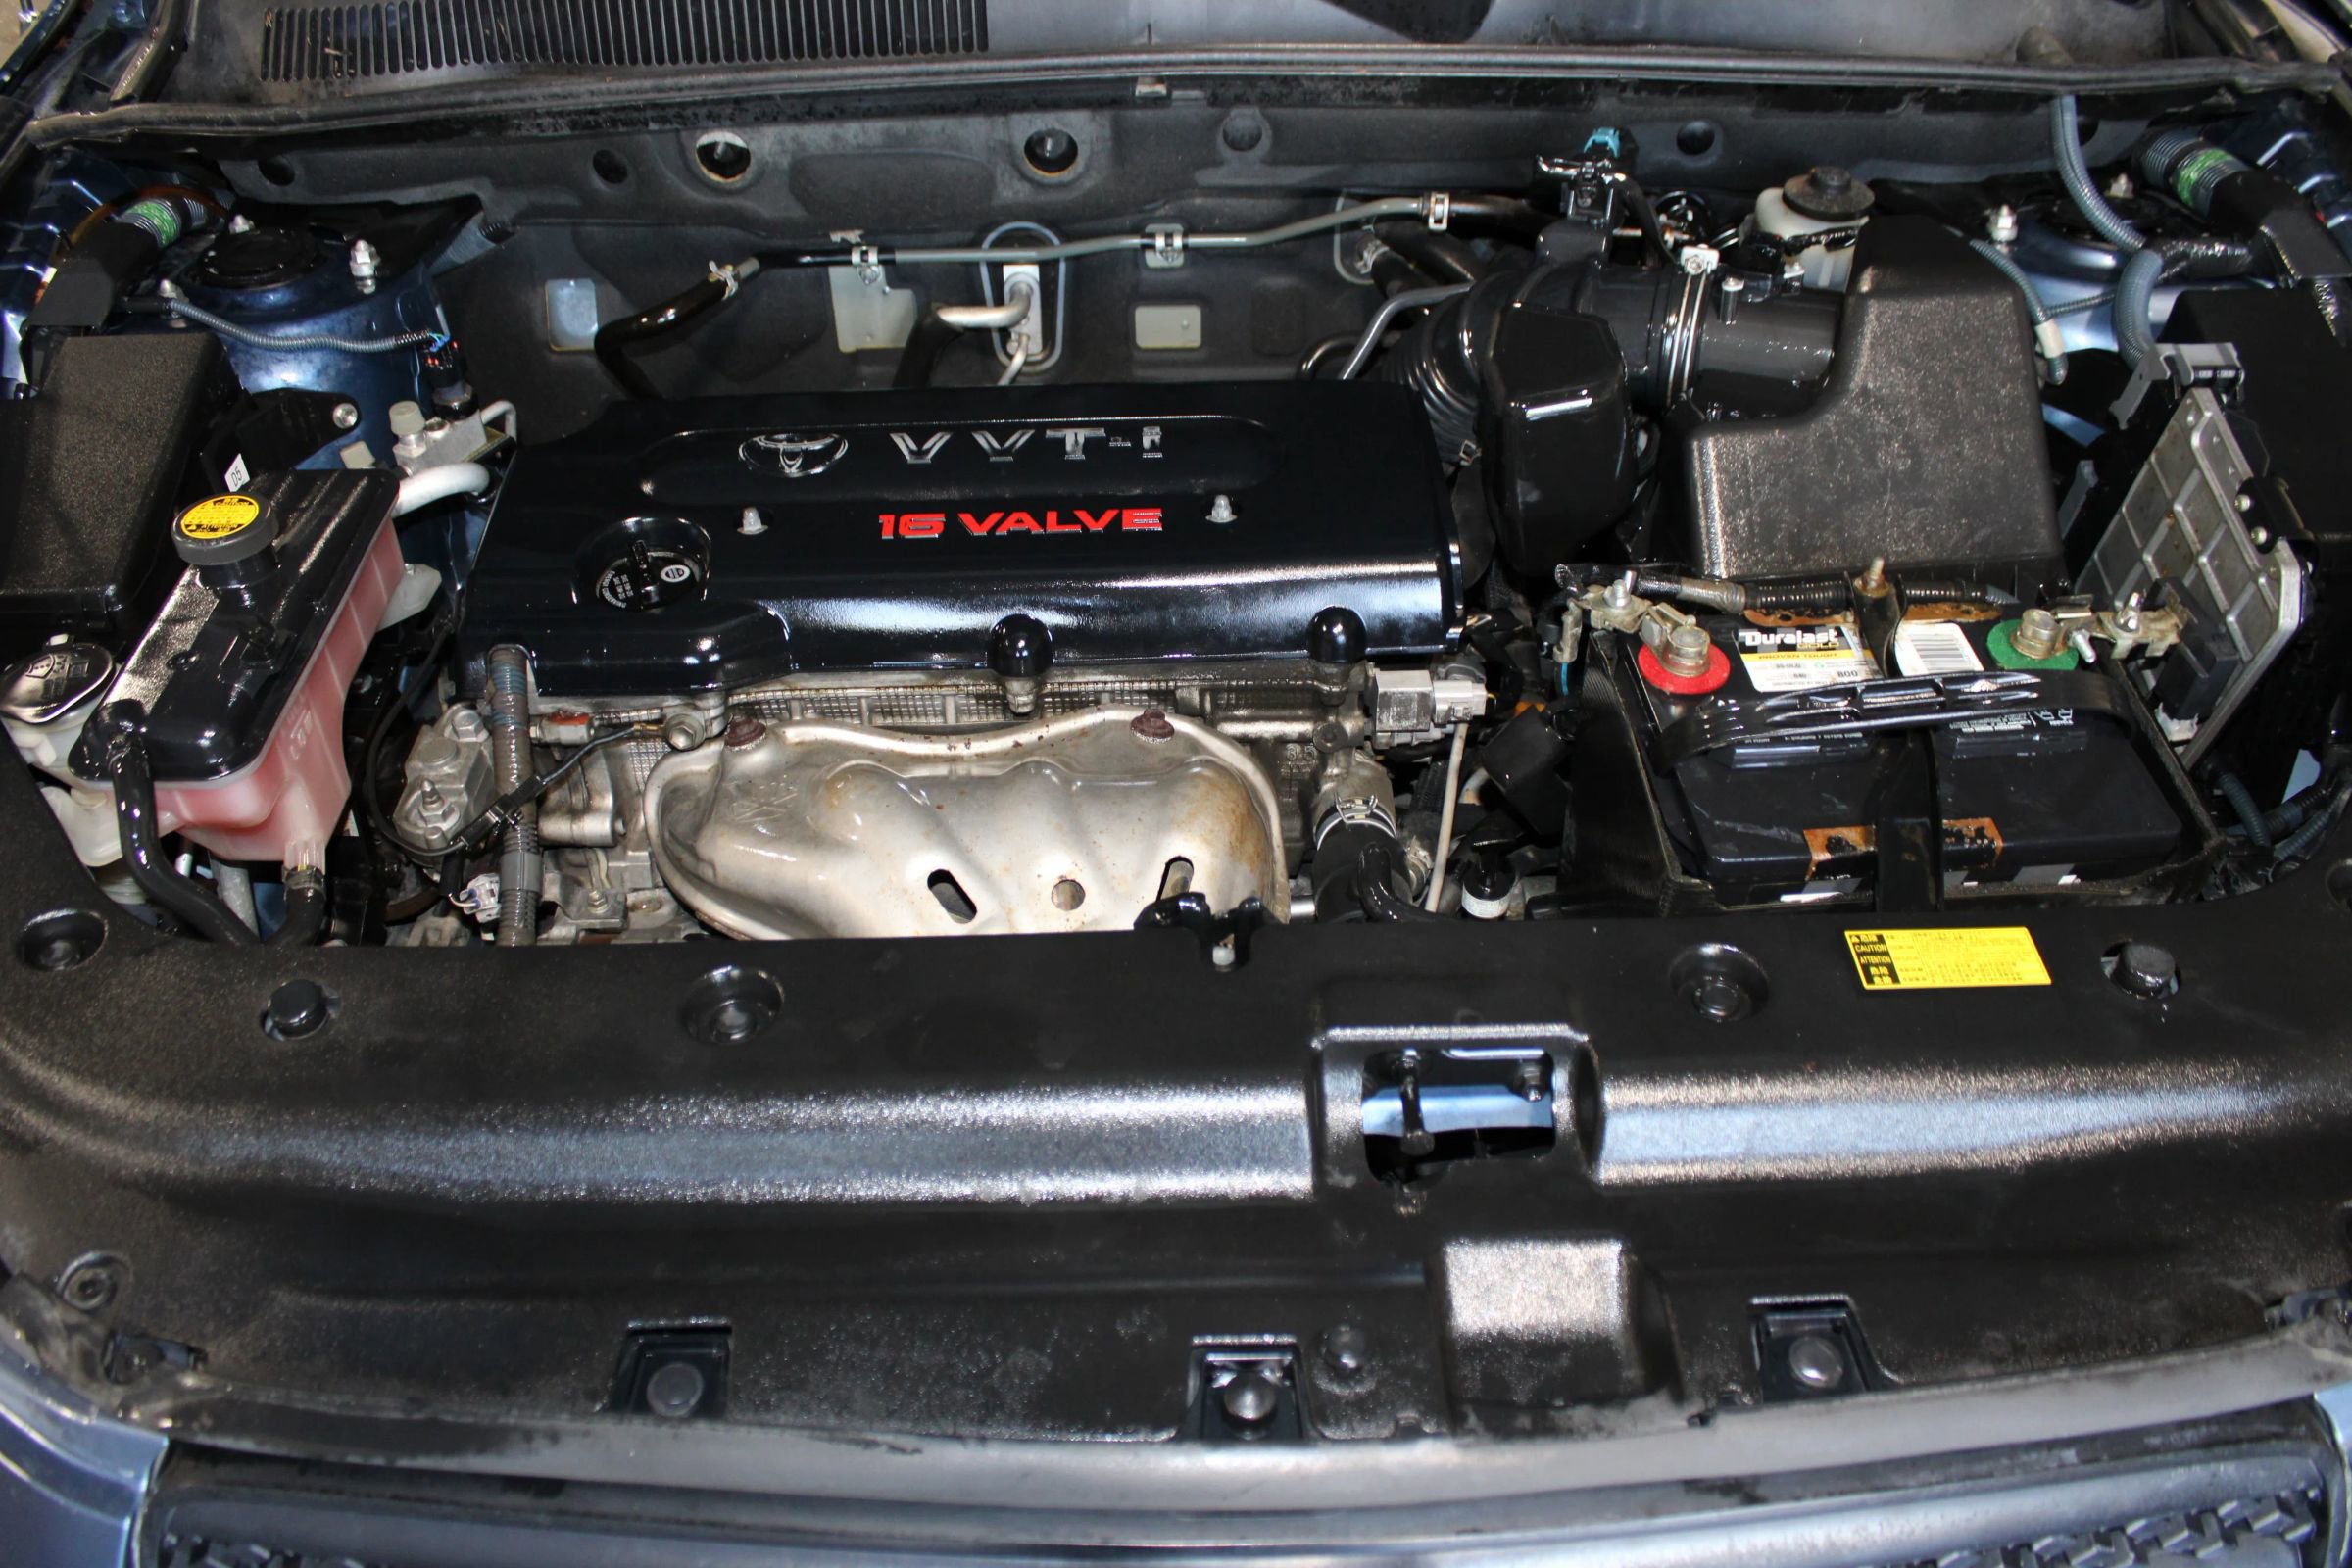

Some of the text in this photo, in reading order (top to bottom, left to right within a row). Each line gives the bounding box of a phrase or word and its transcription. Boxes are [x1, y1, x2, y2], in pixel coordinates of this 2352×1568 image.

[879, 508, 1163, 539] 16 VALVE
[1739, 629, 1838, 646] Duralast
[1854, 943, 1887, 954] CAUTION
[1860, 956, 1892, 964] ATTENTION
